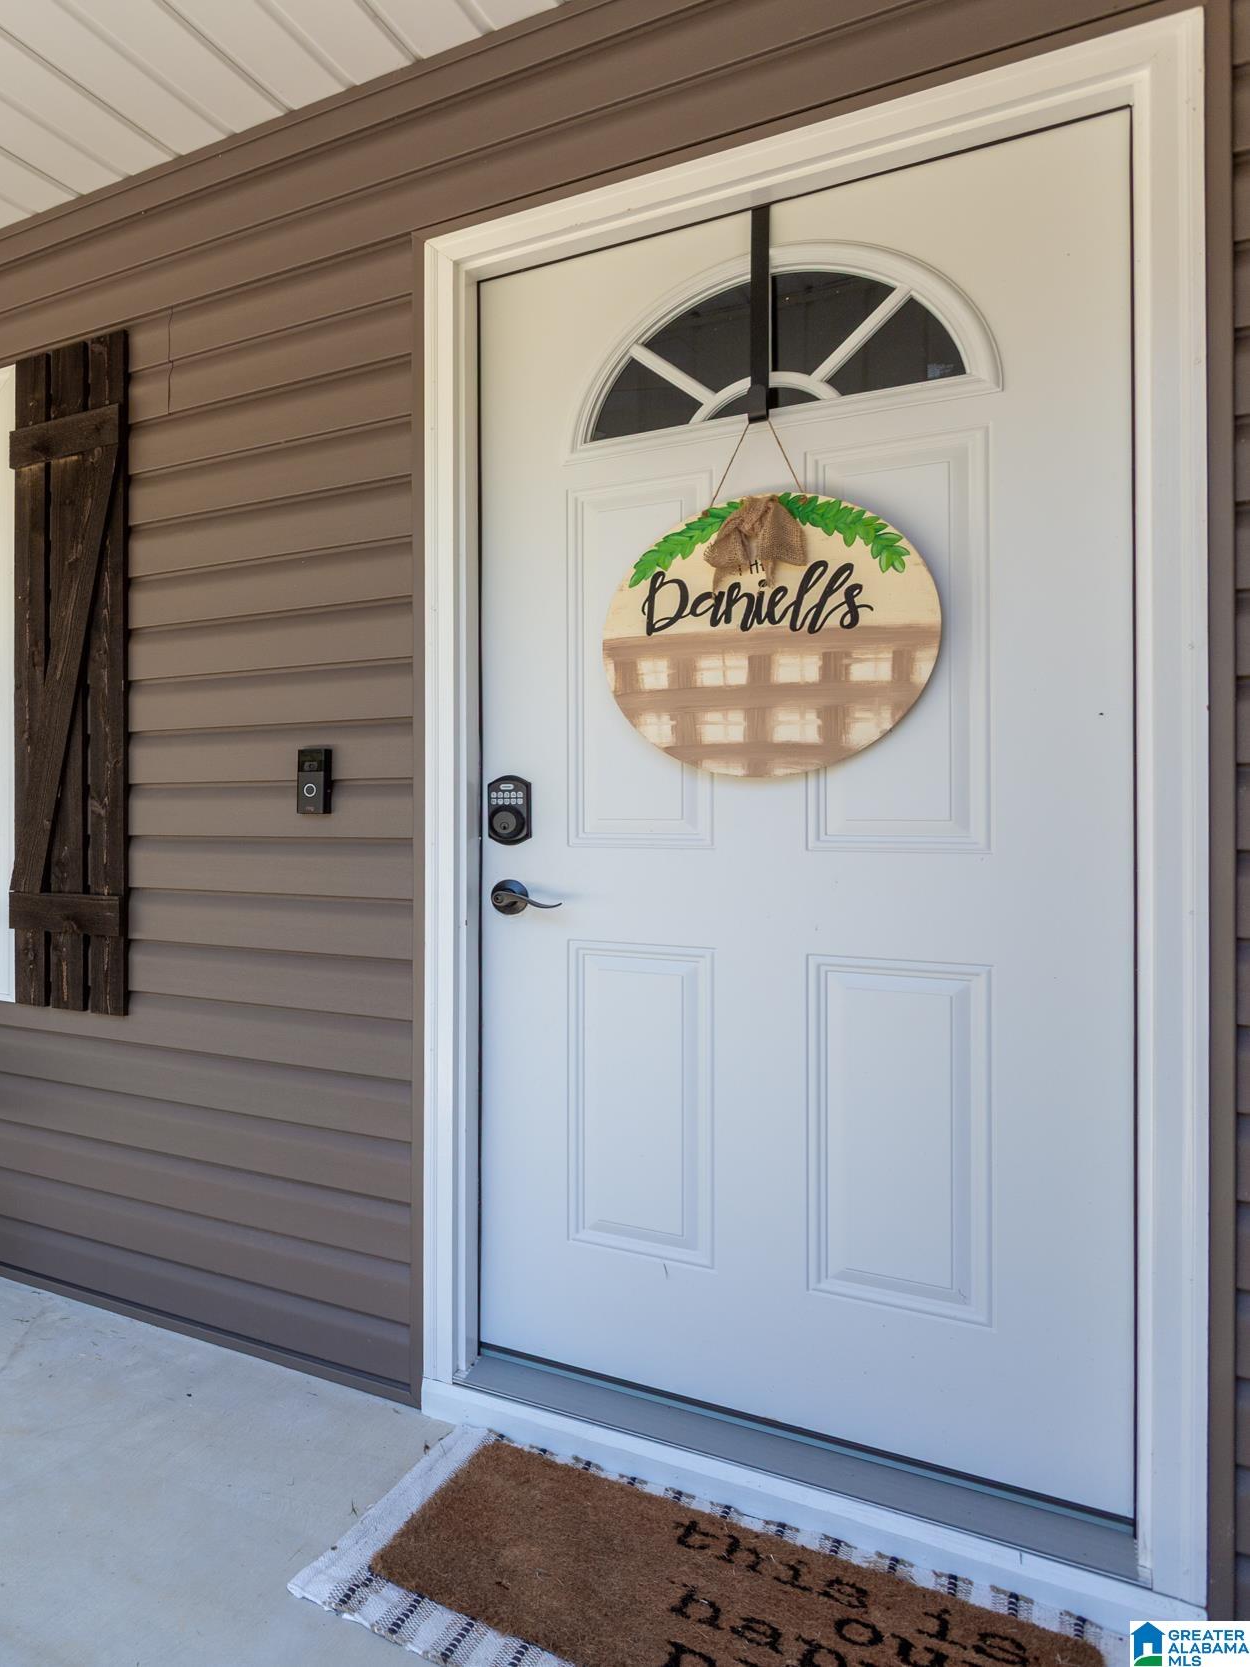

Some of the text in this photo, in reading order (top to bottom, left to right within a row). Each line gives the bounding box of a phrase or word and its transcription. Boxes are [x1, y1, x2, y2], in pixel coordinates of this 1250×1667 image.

[641, 560, 874, 636] Daniells
[674, 1520, 1031, 1665] this is
